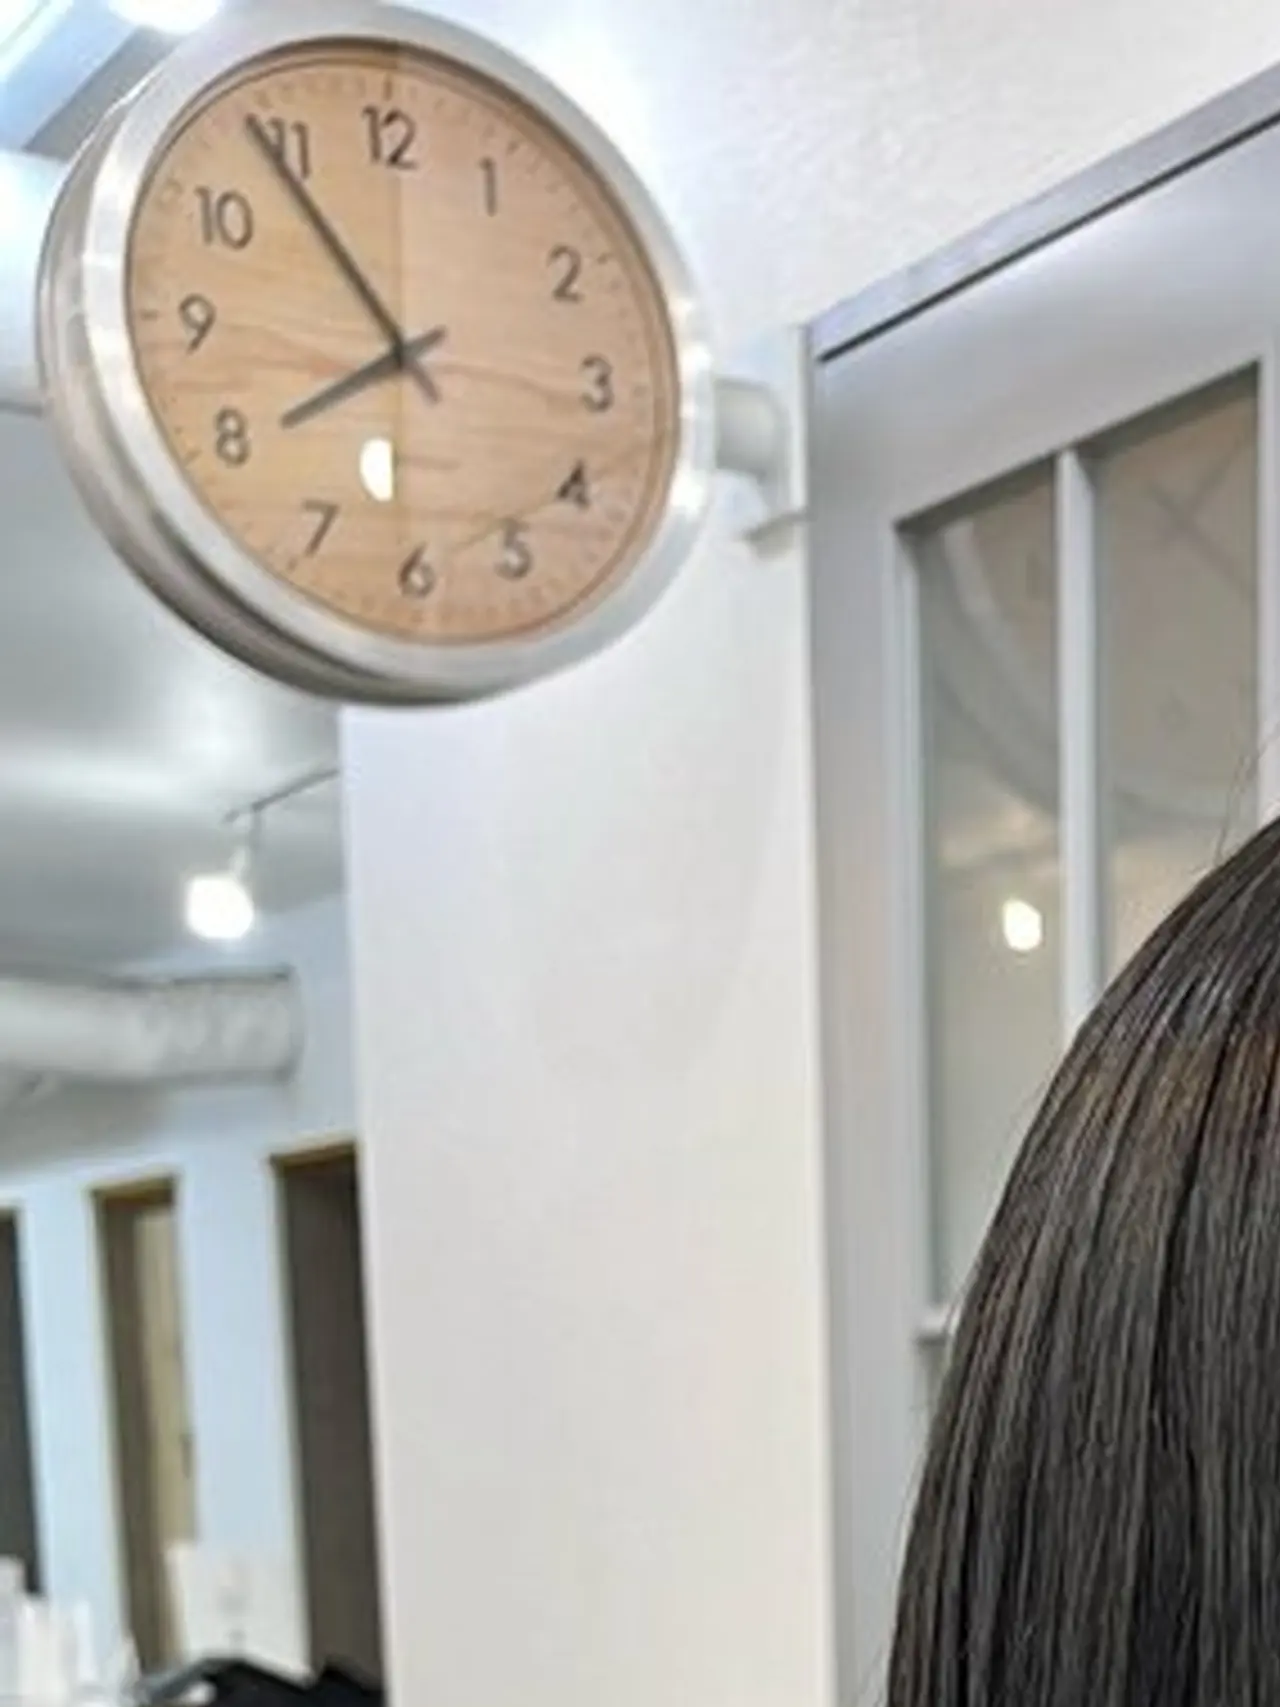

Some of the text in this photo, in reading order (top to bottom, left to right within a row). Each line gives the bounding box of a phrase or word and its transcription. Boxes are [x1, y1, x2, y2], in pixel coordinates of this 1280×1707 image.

[362, 104, 417, 169] 12
[193, 185, 253, 249] 10
[480, 157, 497, 217] 1
[547, 245, 583, 303] 2
[179, 293, 216, 353] 9
[579, 355, 614, 413] 3
[214, 407, 251, 468] 8
[555, 461, 588, 509] 4
[301, 499, 339, 556] 7
[495, 517, 532, 581] 5
[398, 544, 435, 599] 6
